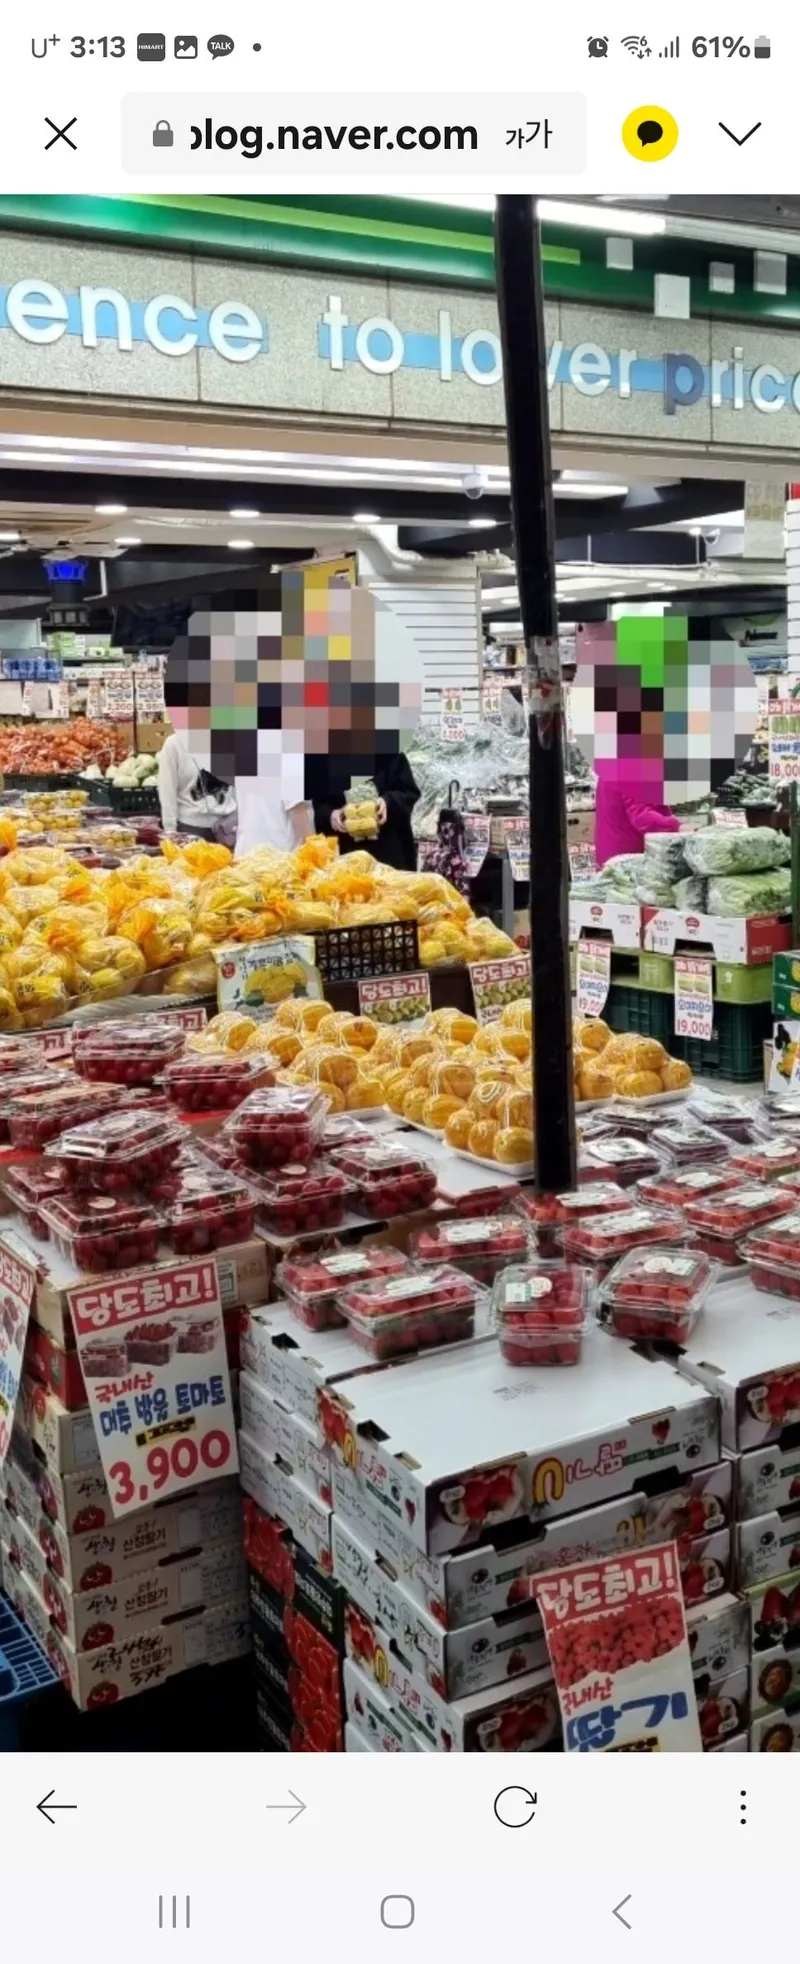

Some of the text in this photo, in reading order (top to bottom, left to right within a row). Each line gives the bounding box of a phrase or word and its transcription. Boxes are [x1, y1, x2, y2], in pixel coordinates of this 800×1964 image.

[70, 36, 126, 58] 3:13
[210, 41, 232, 50] TALK
[692, 36, 751, 58] 61%
[7, 279, 265, 363] ence
[323, 296, 404, 375] to
[664, 346, 800, 416] pric
[76, 1267, 215, 1327] 당도최고!
[95, 1371, 155, 1404] 국내산
[135, 1388, 169, 1426] 방울
[175, 1375, 226, 1415] 토마토
[109, 1429, 231, 1504] 3,900
[537, 1551, 675, 1619] 당도최고!
